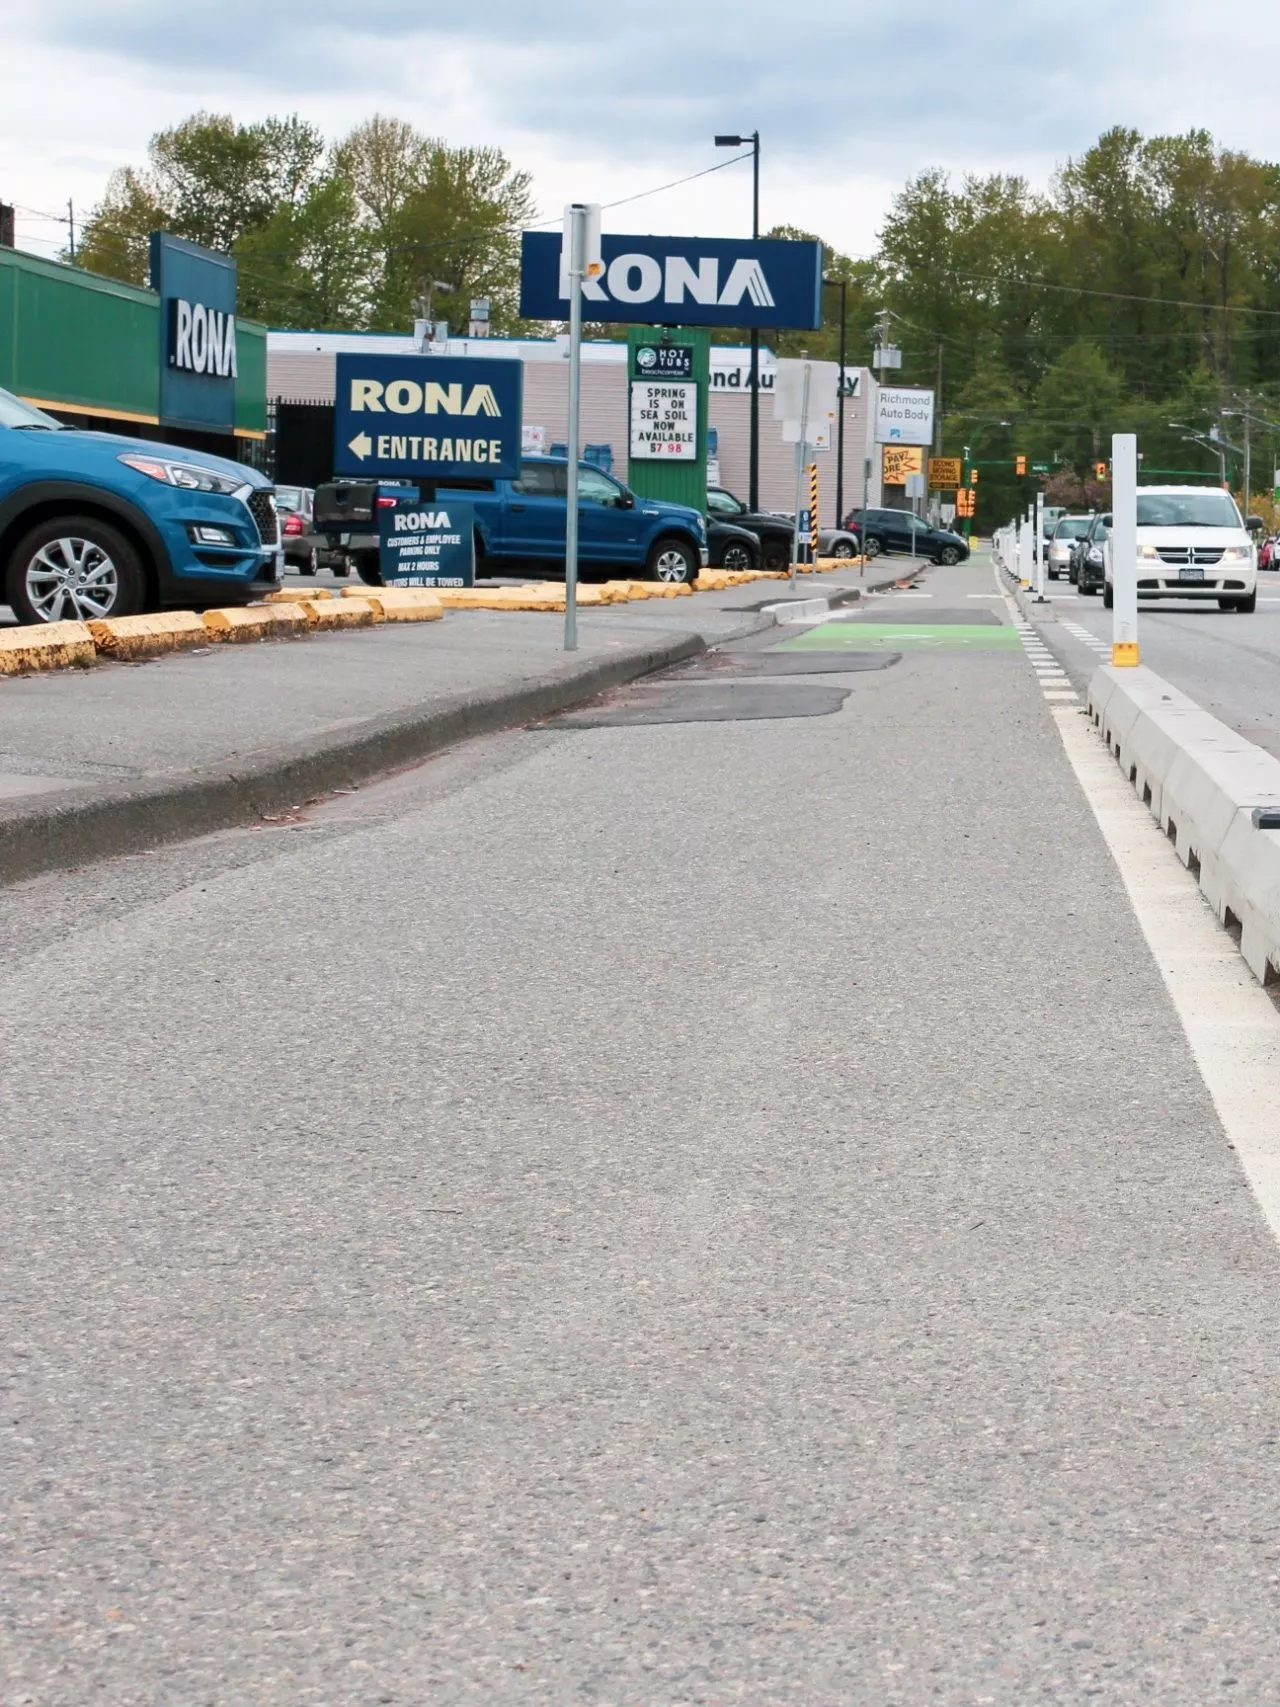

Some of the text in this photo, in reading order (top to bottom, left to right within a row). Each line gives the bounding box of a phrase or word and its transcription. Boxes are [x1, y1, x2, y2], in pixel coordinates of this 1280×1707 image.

[559, 253, 776, 307] RONA
[176, 299, 238, 378] RONA
[659, 349, 685, 358] HOT
[660, 358, 690, 367] TUBS
[351, 379, 502, 417] RONA
[647, 388, 686, 398] SPRING
[649, 400, 684, 409] IS ON
[880, 393, 930, 405] Richmond
[640, 410, 688, 420] SEA SOIL
[880, 407, 929, 421] Auto Body
[653, 421, 675, 430] NOW
[639, 432, 693, 442] AVAILABLE
[377, 435, 502, 463] ENTRANCE
[668, 444, 682, 453] 98
[887, 453, 904, 464] PAY
[394, 511, 452, 531] RONA
[387, 535, 420, 547] CUSTOMERS
[425, 534, 461, 544] EMPLOYEE
[399, 545, 441, 556] PARKING ONLY
[398, 561, 440, 572] MAX 2 HOURS
[409, 577, 425, 587] WILL
[425, 577, 437, 587] BE
[438, 577, 464, 587] TOWED
